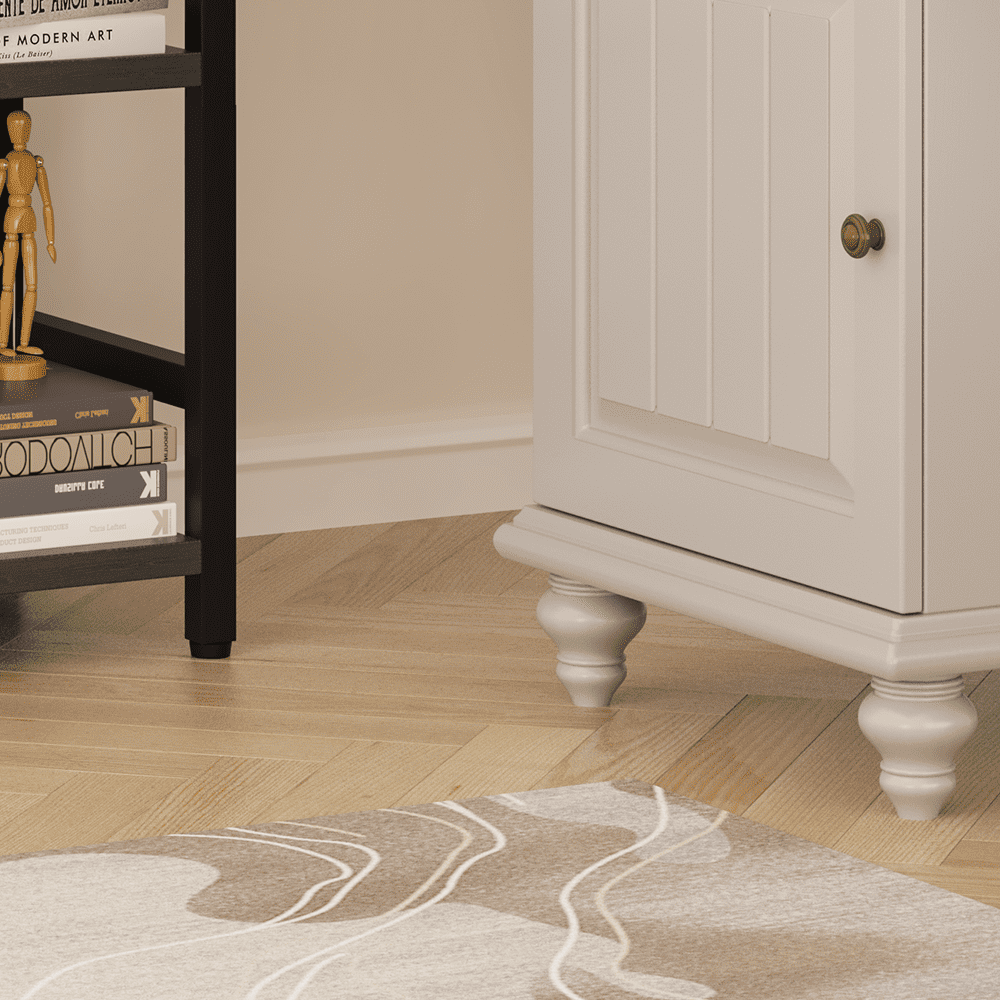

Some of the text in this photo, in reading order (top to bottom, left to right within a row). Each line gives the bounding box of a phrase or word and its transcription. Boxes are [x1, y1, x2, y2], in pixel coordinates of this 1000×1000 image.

[16, 31, 81, 46] MODERN
[86, 29, 114, 42] ART
[89, 523, 108, 533] Chris
